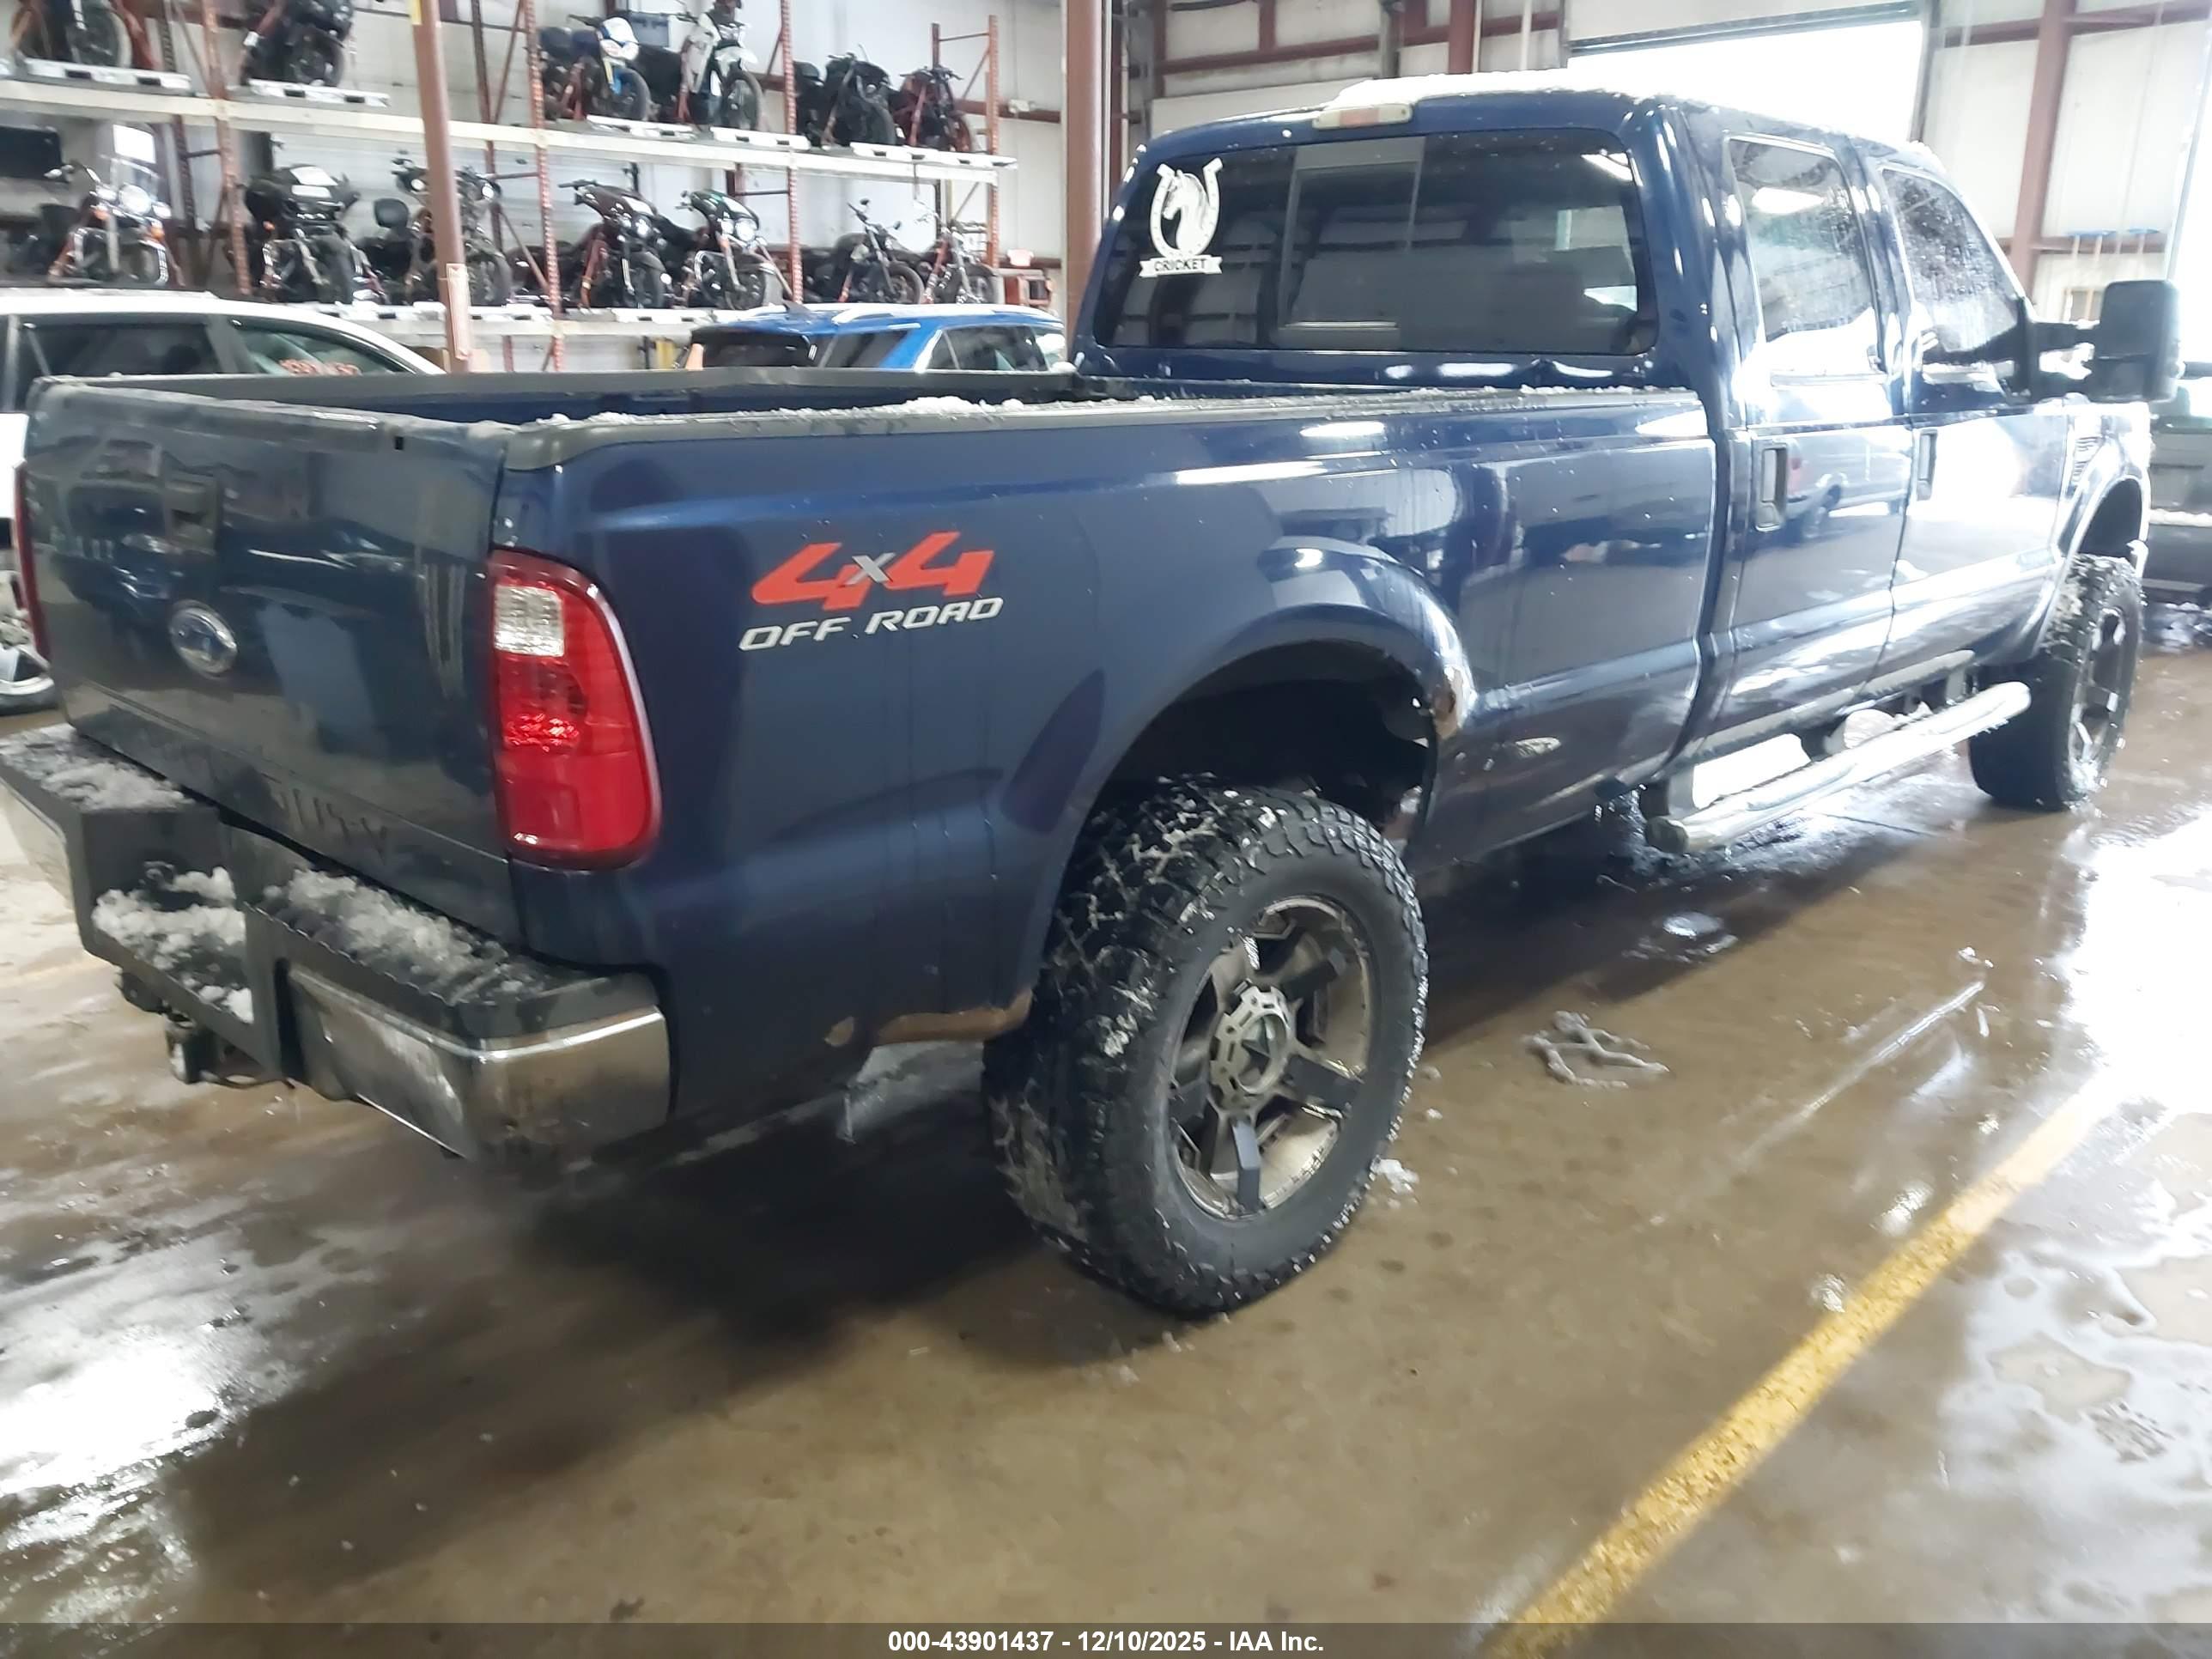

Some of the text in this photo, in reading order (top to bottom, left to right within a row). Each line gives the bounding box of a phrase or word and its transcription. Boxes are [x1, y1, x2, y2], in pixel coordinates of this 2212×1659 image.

[1154, 258, 1206, 271] CRICKET
[739, 598, 1003, 650] OFF ROAD
